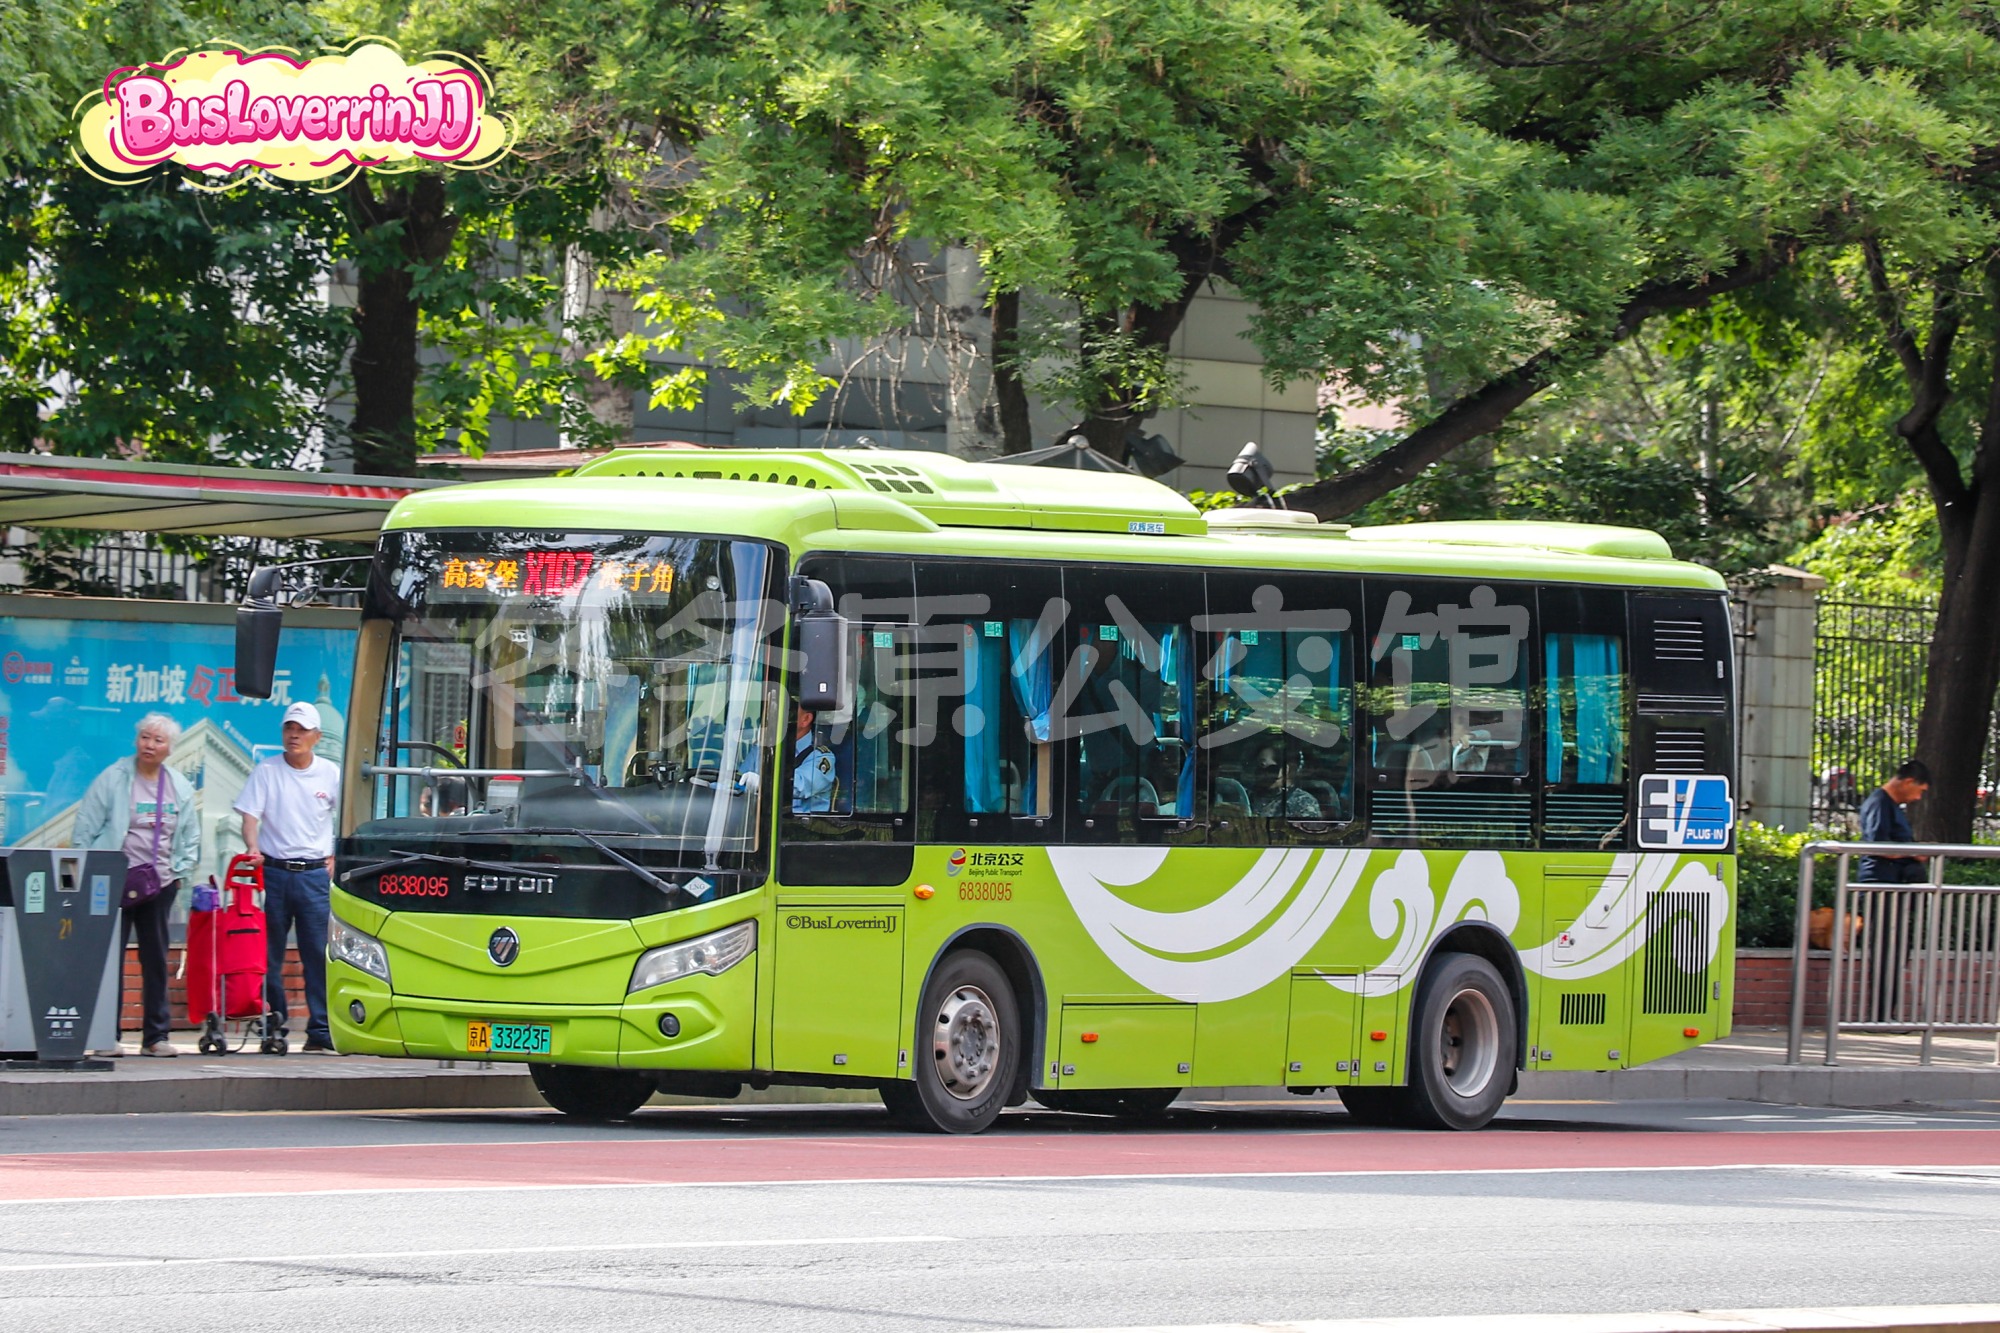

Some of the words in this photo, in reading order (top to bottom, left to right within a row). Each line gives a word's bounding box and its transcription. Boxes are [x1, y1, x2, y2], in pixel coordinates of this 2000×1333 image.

[443, 557, 519, 589] 高家堡
[523, 551, 594, 596] X107
[1686, 829, 1723, 840] PLUG-IN
[970, 853, 1024, 866] 北京公交
[968, 868, 984, 877] Beijing
[985, 868, 999, 876] Public
[1000, 868, 1023, 877] Transport
[379, 874, 449, 897] 6838095
[463, 875, 553, 894] FOTON
[689, 883, 706, 891] LNG
[959, 881, 1013, 901] 6838095
